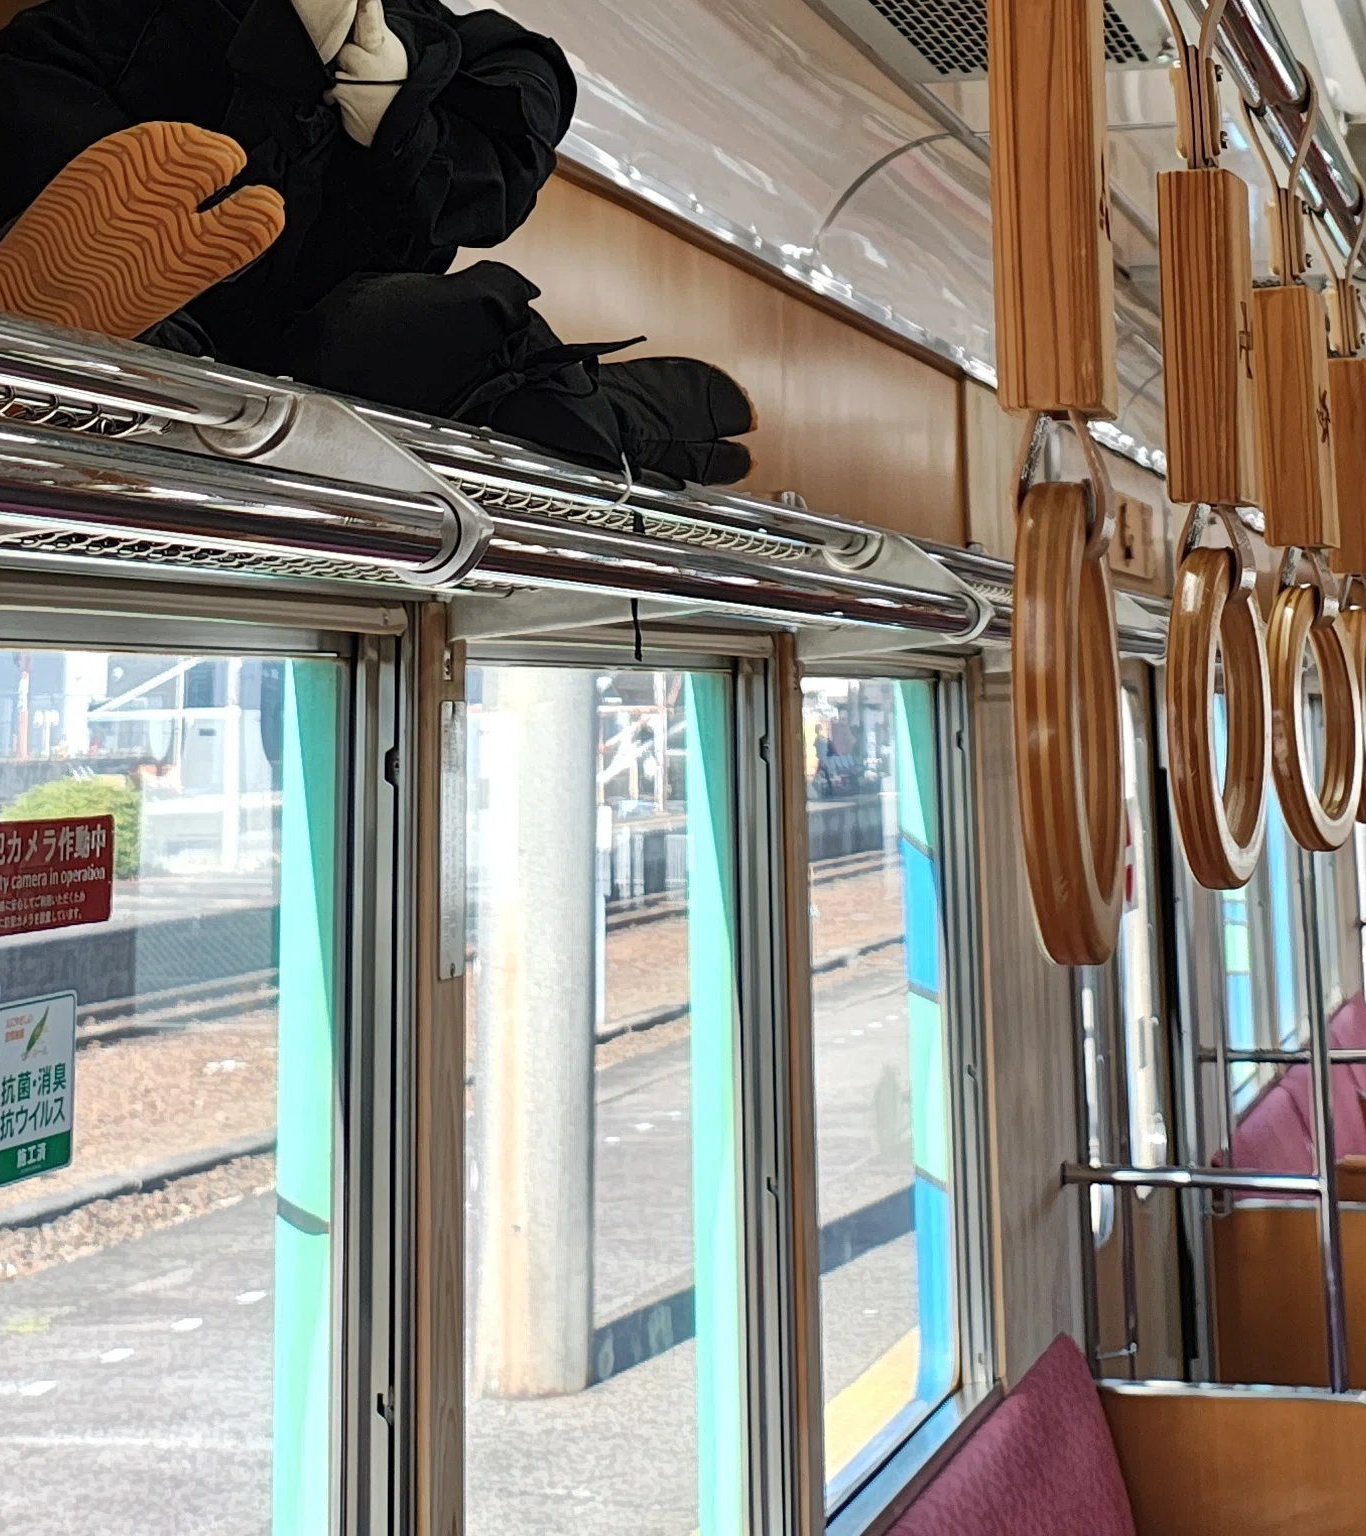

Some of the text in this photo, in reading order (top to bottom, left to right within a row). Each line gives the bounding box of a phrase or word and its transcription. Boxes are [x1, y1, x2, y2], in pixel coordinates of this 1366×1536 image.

[11, 870, 48, 891] camera
[49, 869, 59, 884] in
[60, 866, 105, 885] operation
[0, 1096, 65, 1142] 抗ウイルス
